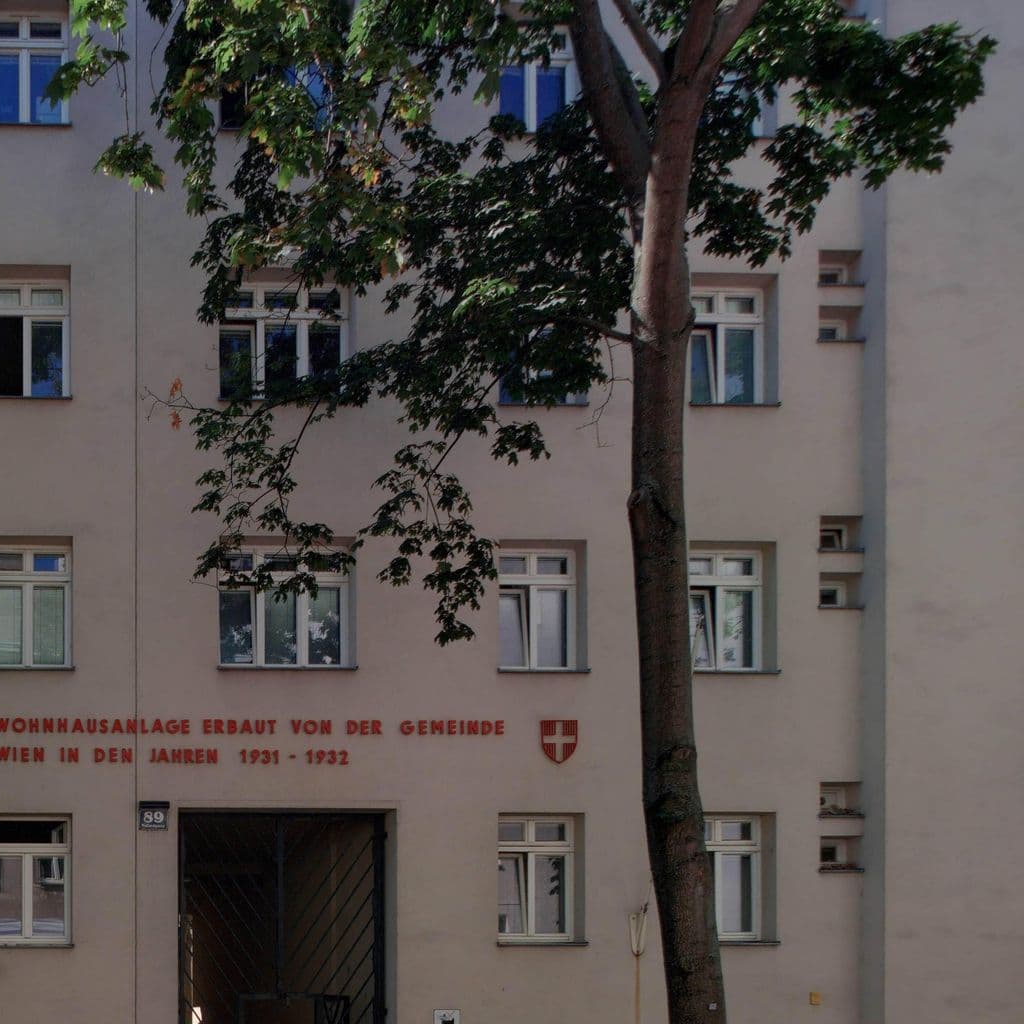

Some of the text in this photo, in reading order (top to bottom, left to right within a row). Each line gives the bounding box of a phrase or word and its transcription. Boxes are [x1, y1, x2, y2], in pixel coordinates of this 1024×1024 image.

[203, 719, 277, 735] ERBAUT
[291, 720, 332, 735] VON
[347, 720, 382, 736] DER
[400, 720, 505, 736] GEMEINDE
[60, 747, 79, 763] IN
[94, 747, 133, 764] DEN
[151, 748, 219, 764] JAHREN
[241, 748, 280, 765] 1931
[307, 749, 349, 766] 1932
[144, 811, 164, 823] 89
